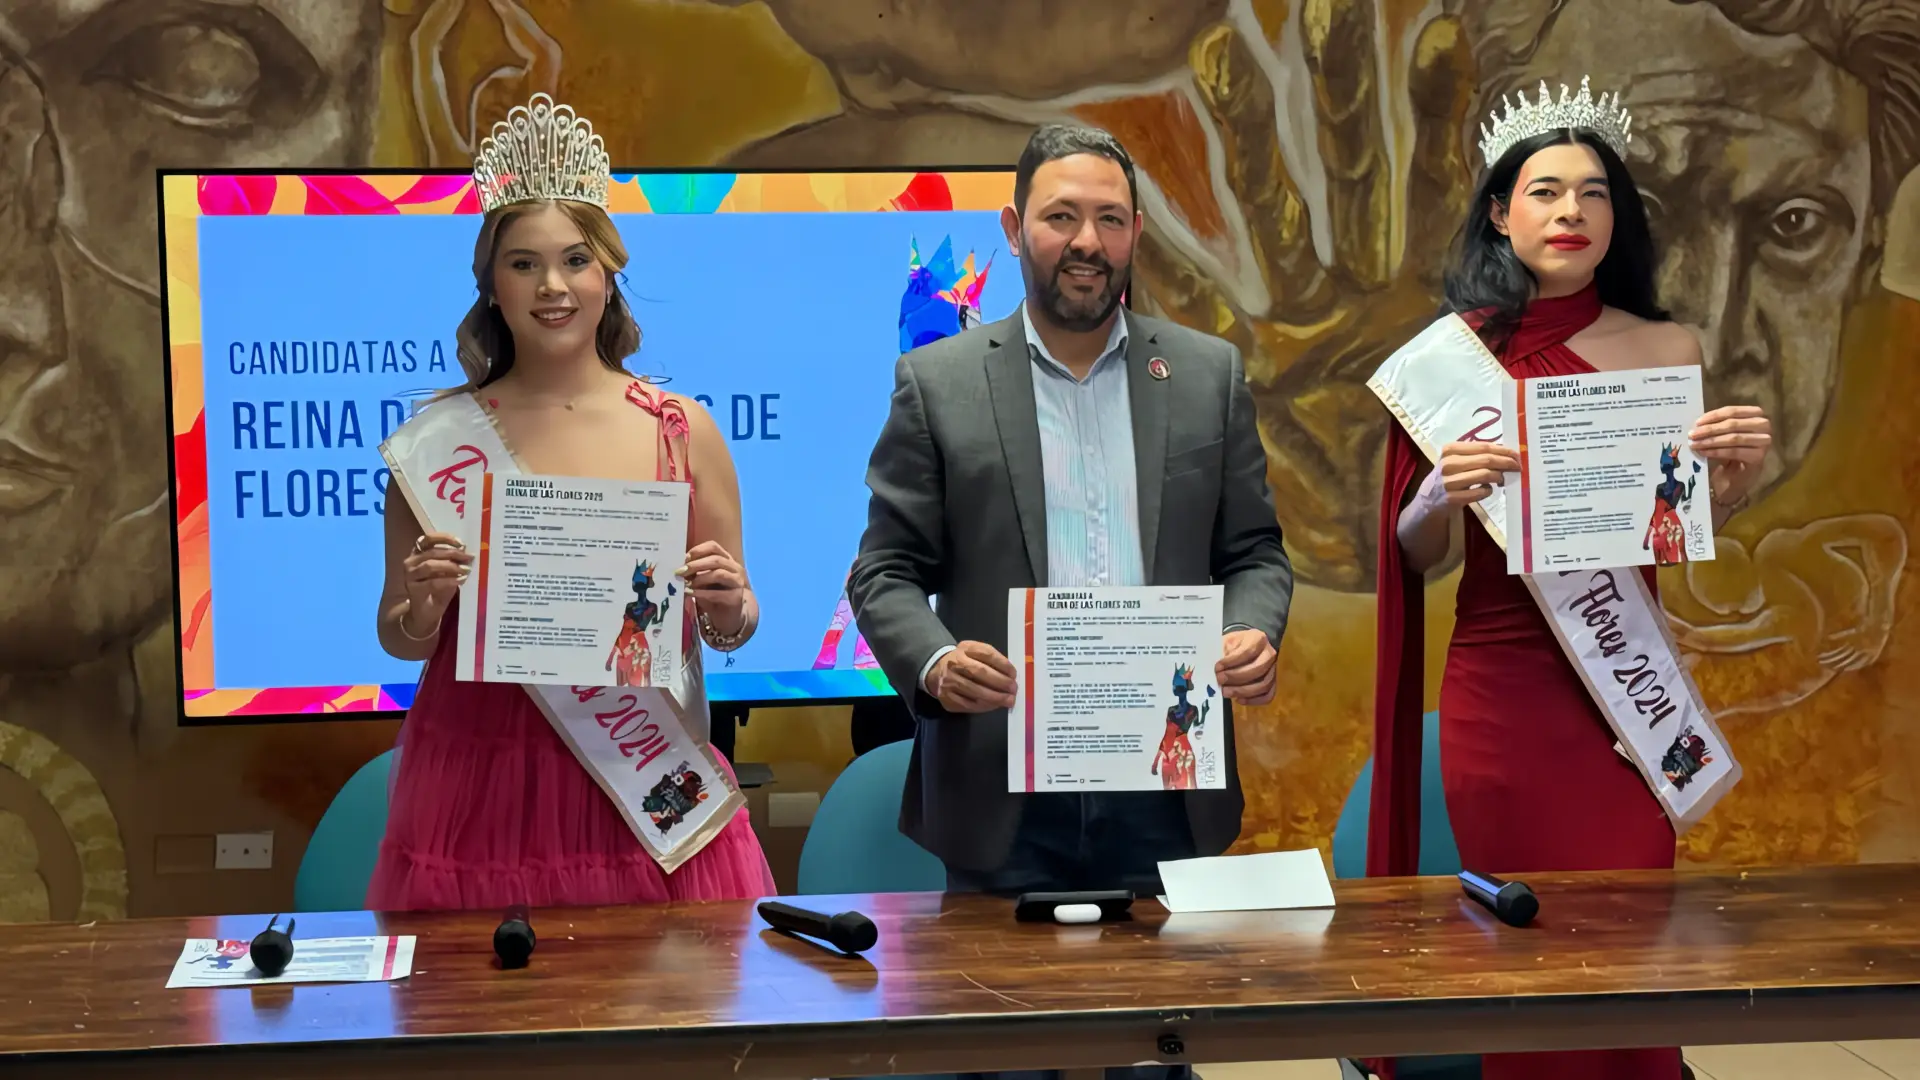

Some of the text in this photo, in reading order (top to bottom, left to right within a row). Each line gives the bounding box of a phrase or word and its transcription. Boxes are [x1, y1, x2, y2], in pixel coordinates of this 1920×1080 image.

[229, 339, 446, 375] CANDIDATAS A
[1568, 387, 1581, 397] LAS
[232, 399, 365, 450] REINA
[731, 393, 781, 441] DE
[540, 490, 554, 499] LAS
[1080, 600, 1094, 609] LAS
[1568, 568, 1627, 658] Flores
[1612, 654, 1677, 730] 2024
[594, 694, 671, 772] 2024
